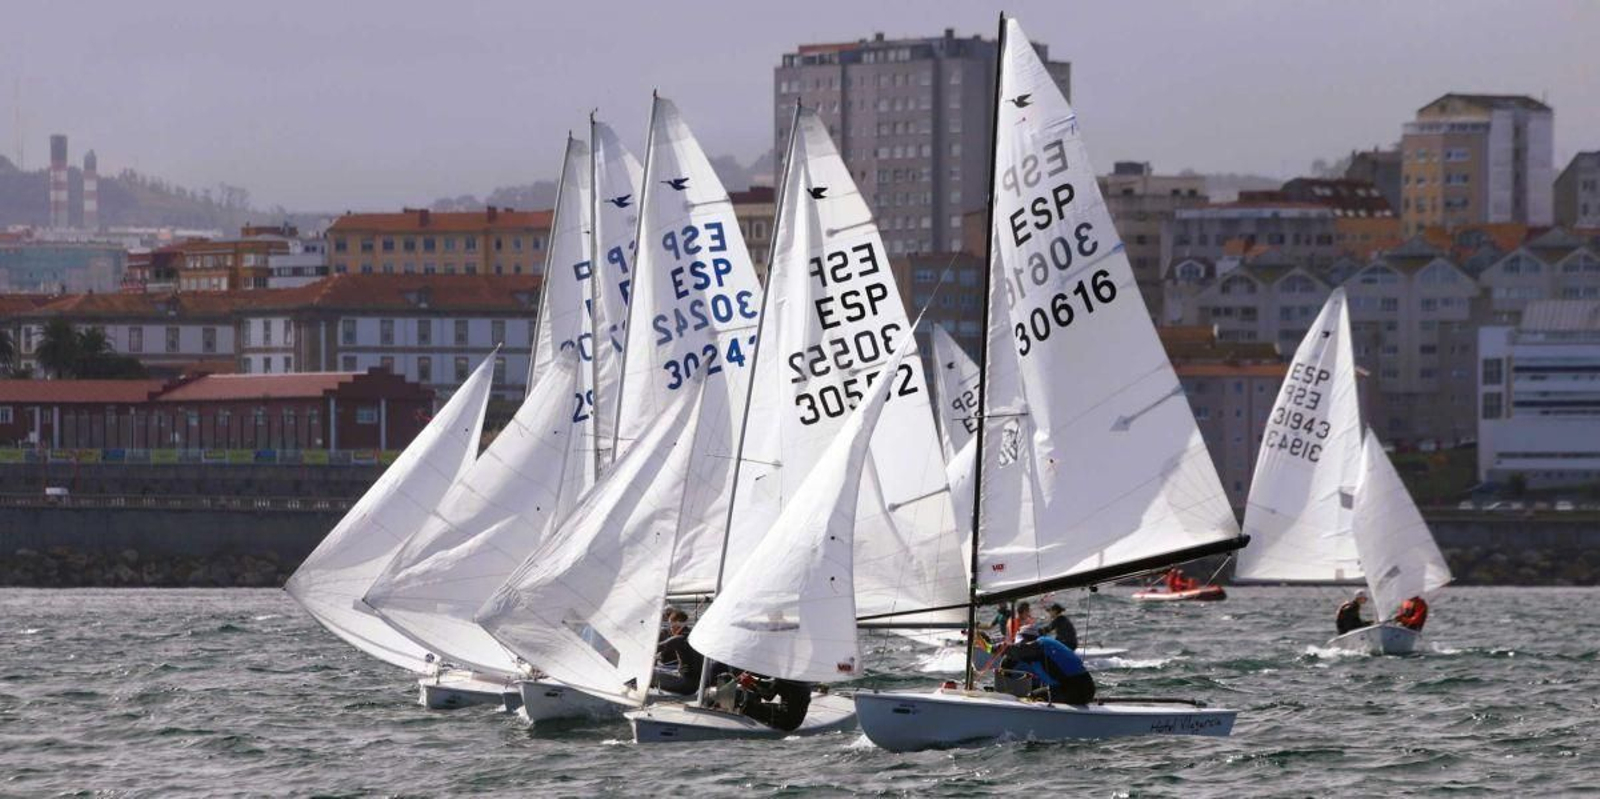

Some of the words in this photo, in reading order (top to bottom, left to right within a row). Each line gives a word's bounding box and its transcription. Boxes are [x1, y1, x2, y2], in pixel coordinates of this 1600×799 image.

[1010, 183, 1075, 247] ESP
[670, 258, 732, 300] ESP
[815, 283, 888, 330] ESP
[1015, 269, 1117, 356] 30616
[663, 335, 757, 390] 3024
[1290, 362, 1330, 386] ESP
[1272, 407, 1331, 440] 31943
